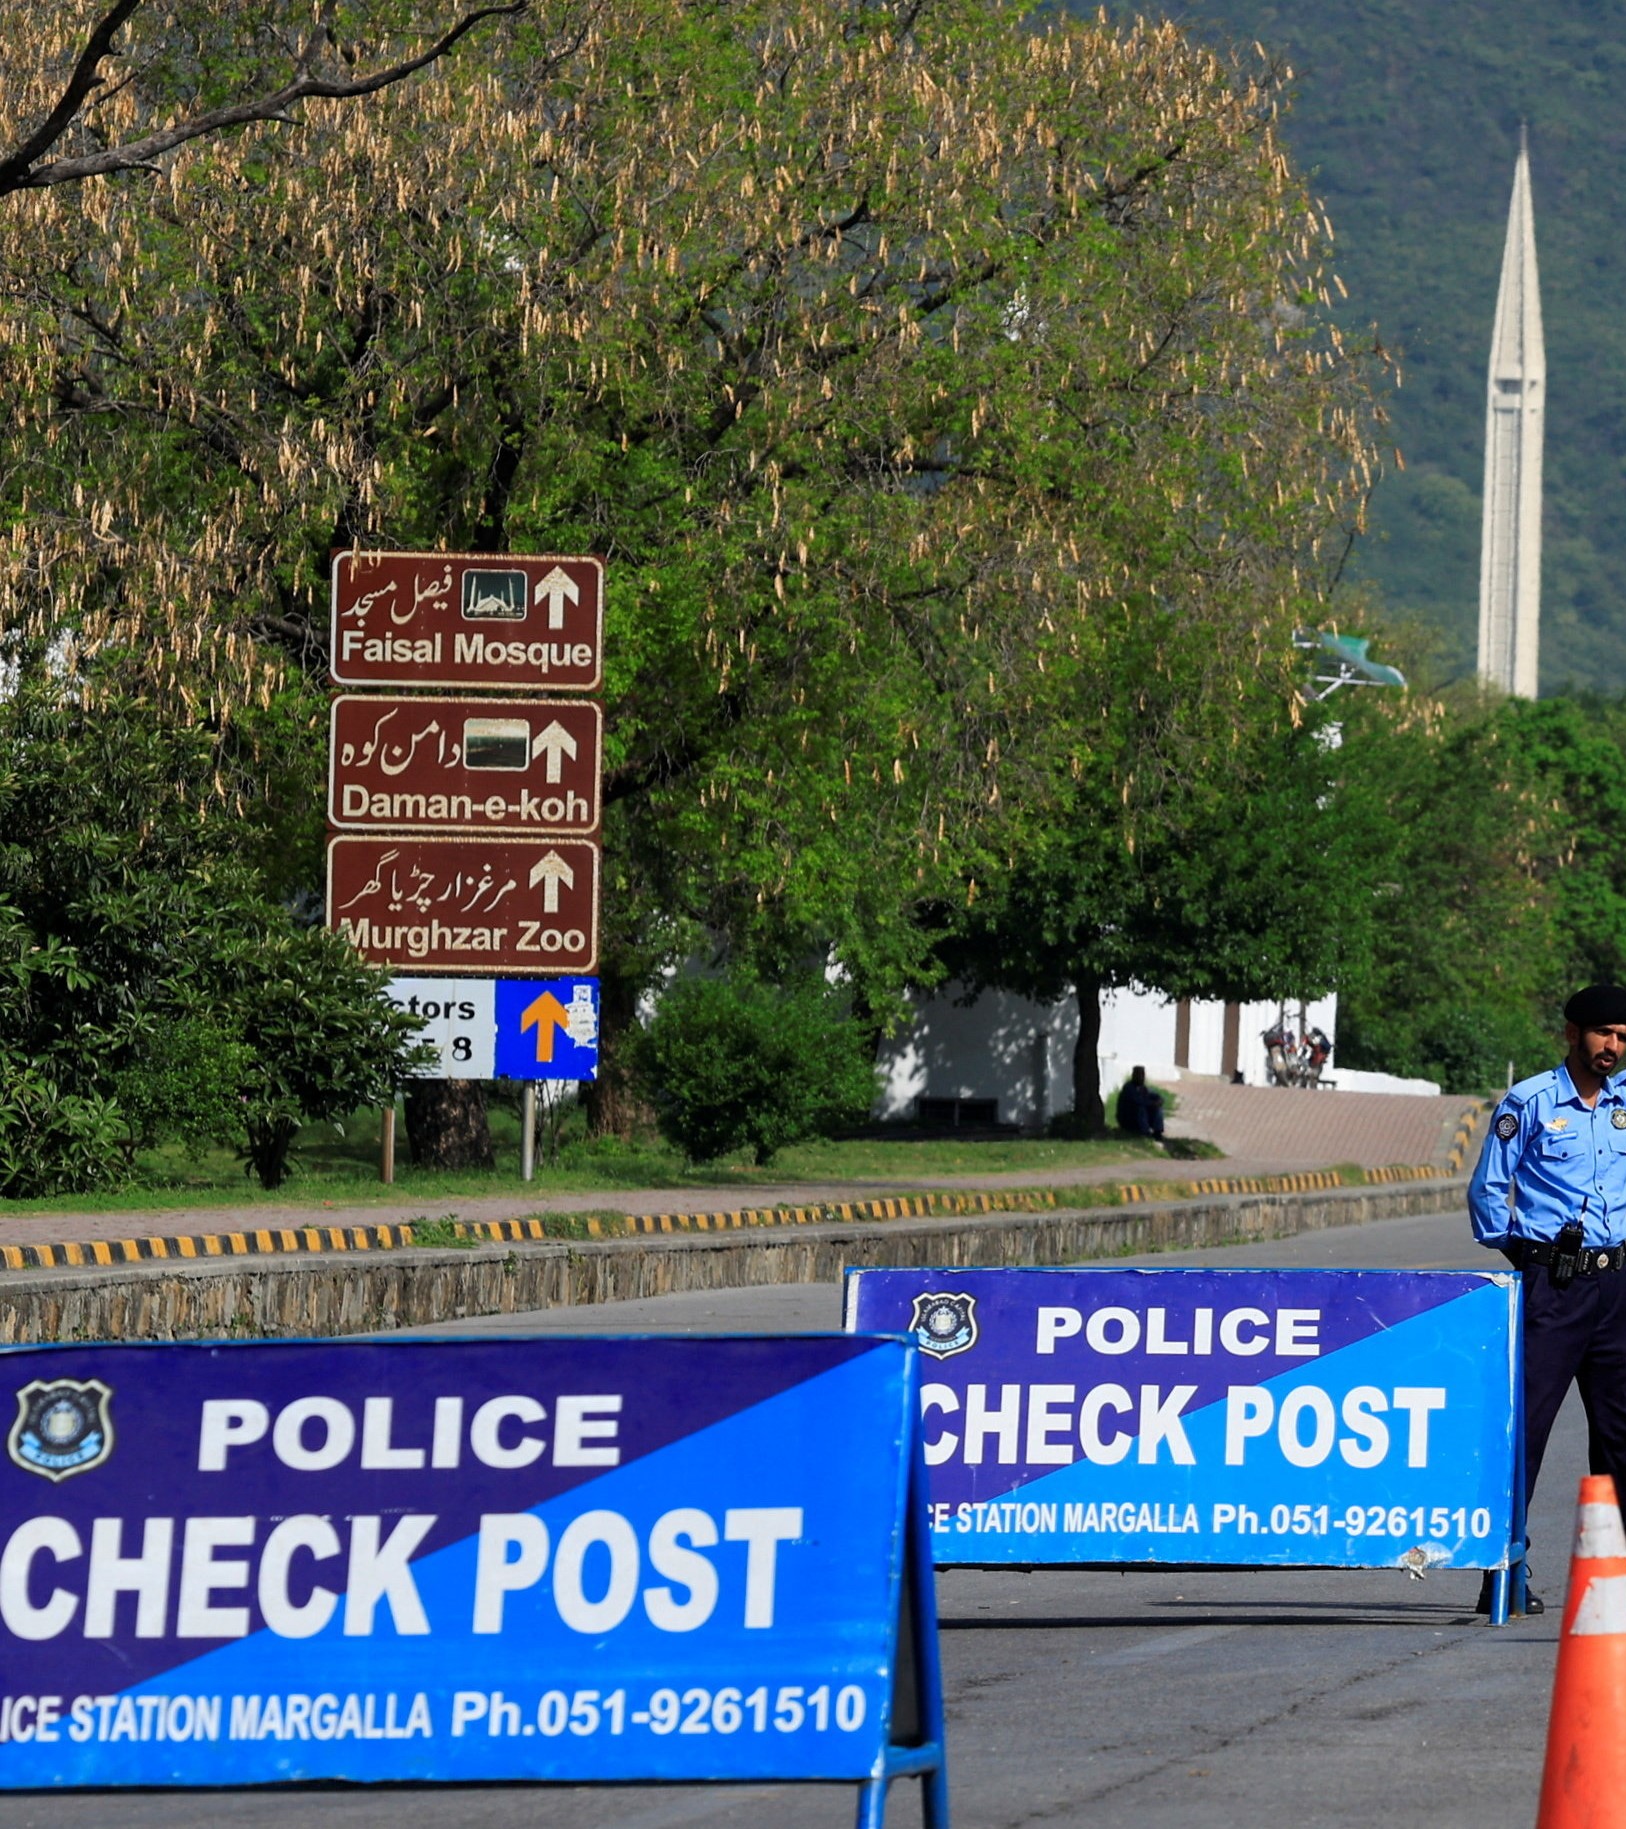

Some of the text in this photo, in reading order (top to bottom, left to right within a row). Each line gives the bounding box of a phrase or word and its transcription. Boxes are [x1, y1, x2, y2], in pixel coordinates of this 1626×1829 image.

[341, 564, 452, 628] فیصل مسجد
[342, 630, 593, 674] Faisal Mosque
[341, 707, 461, 776] دامن کوہ
[342, 784, 588, 822] Daman-e-koh
[338, 849, 400, 909] گھر
[437, 863, 517, 913] مرغزار
[340, 917, 586, 957] Murghzar Zoo
[1035, 1306, 1321, 1356] POLICE
[198, 1395, 623, 1472] POLICE
[922, 1383, 1446, 1468] CHECK POST
[927, 1502, 1491, 1538] E STATION MARGALLA Ph.051-9261510
[0, 1507, 803, 1641] CHECK POST
[0, 1685, 867, 1743] ICE STATION MARGALLA Ph.051-9261510
